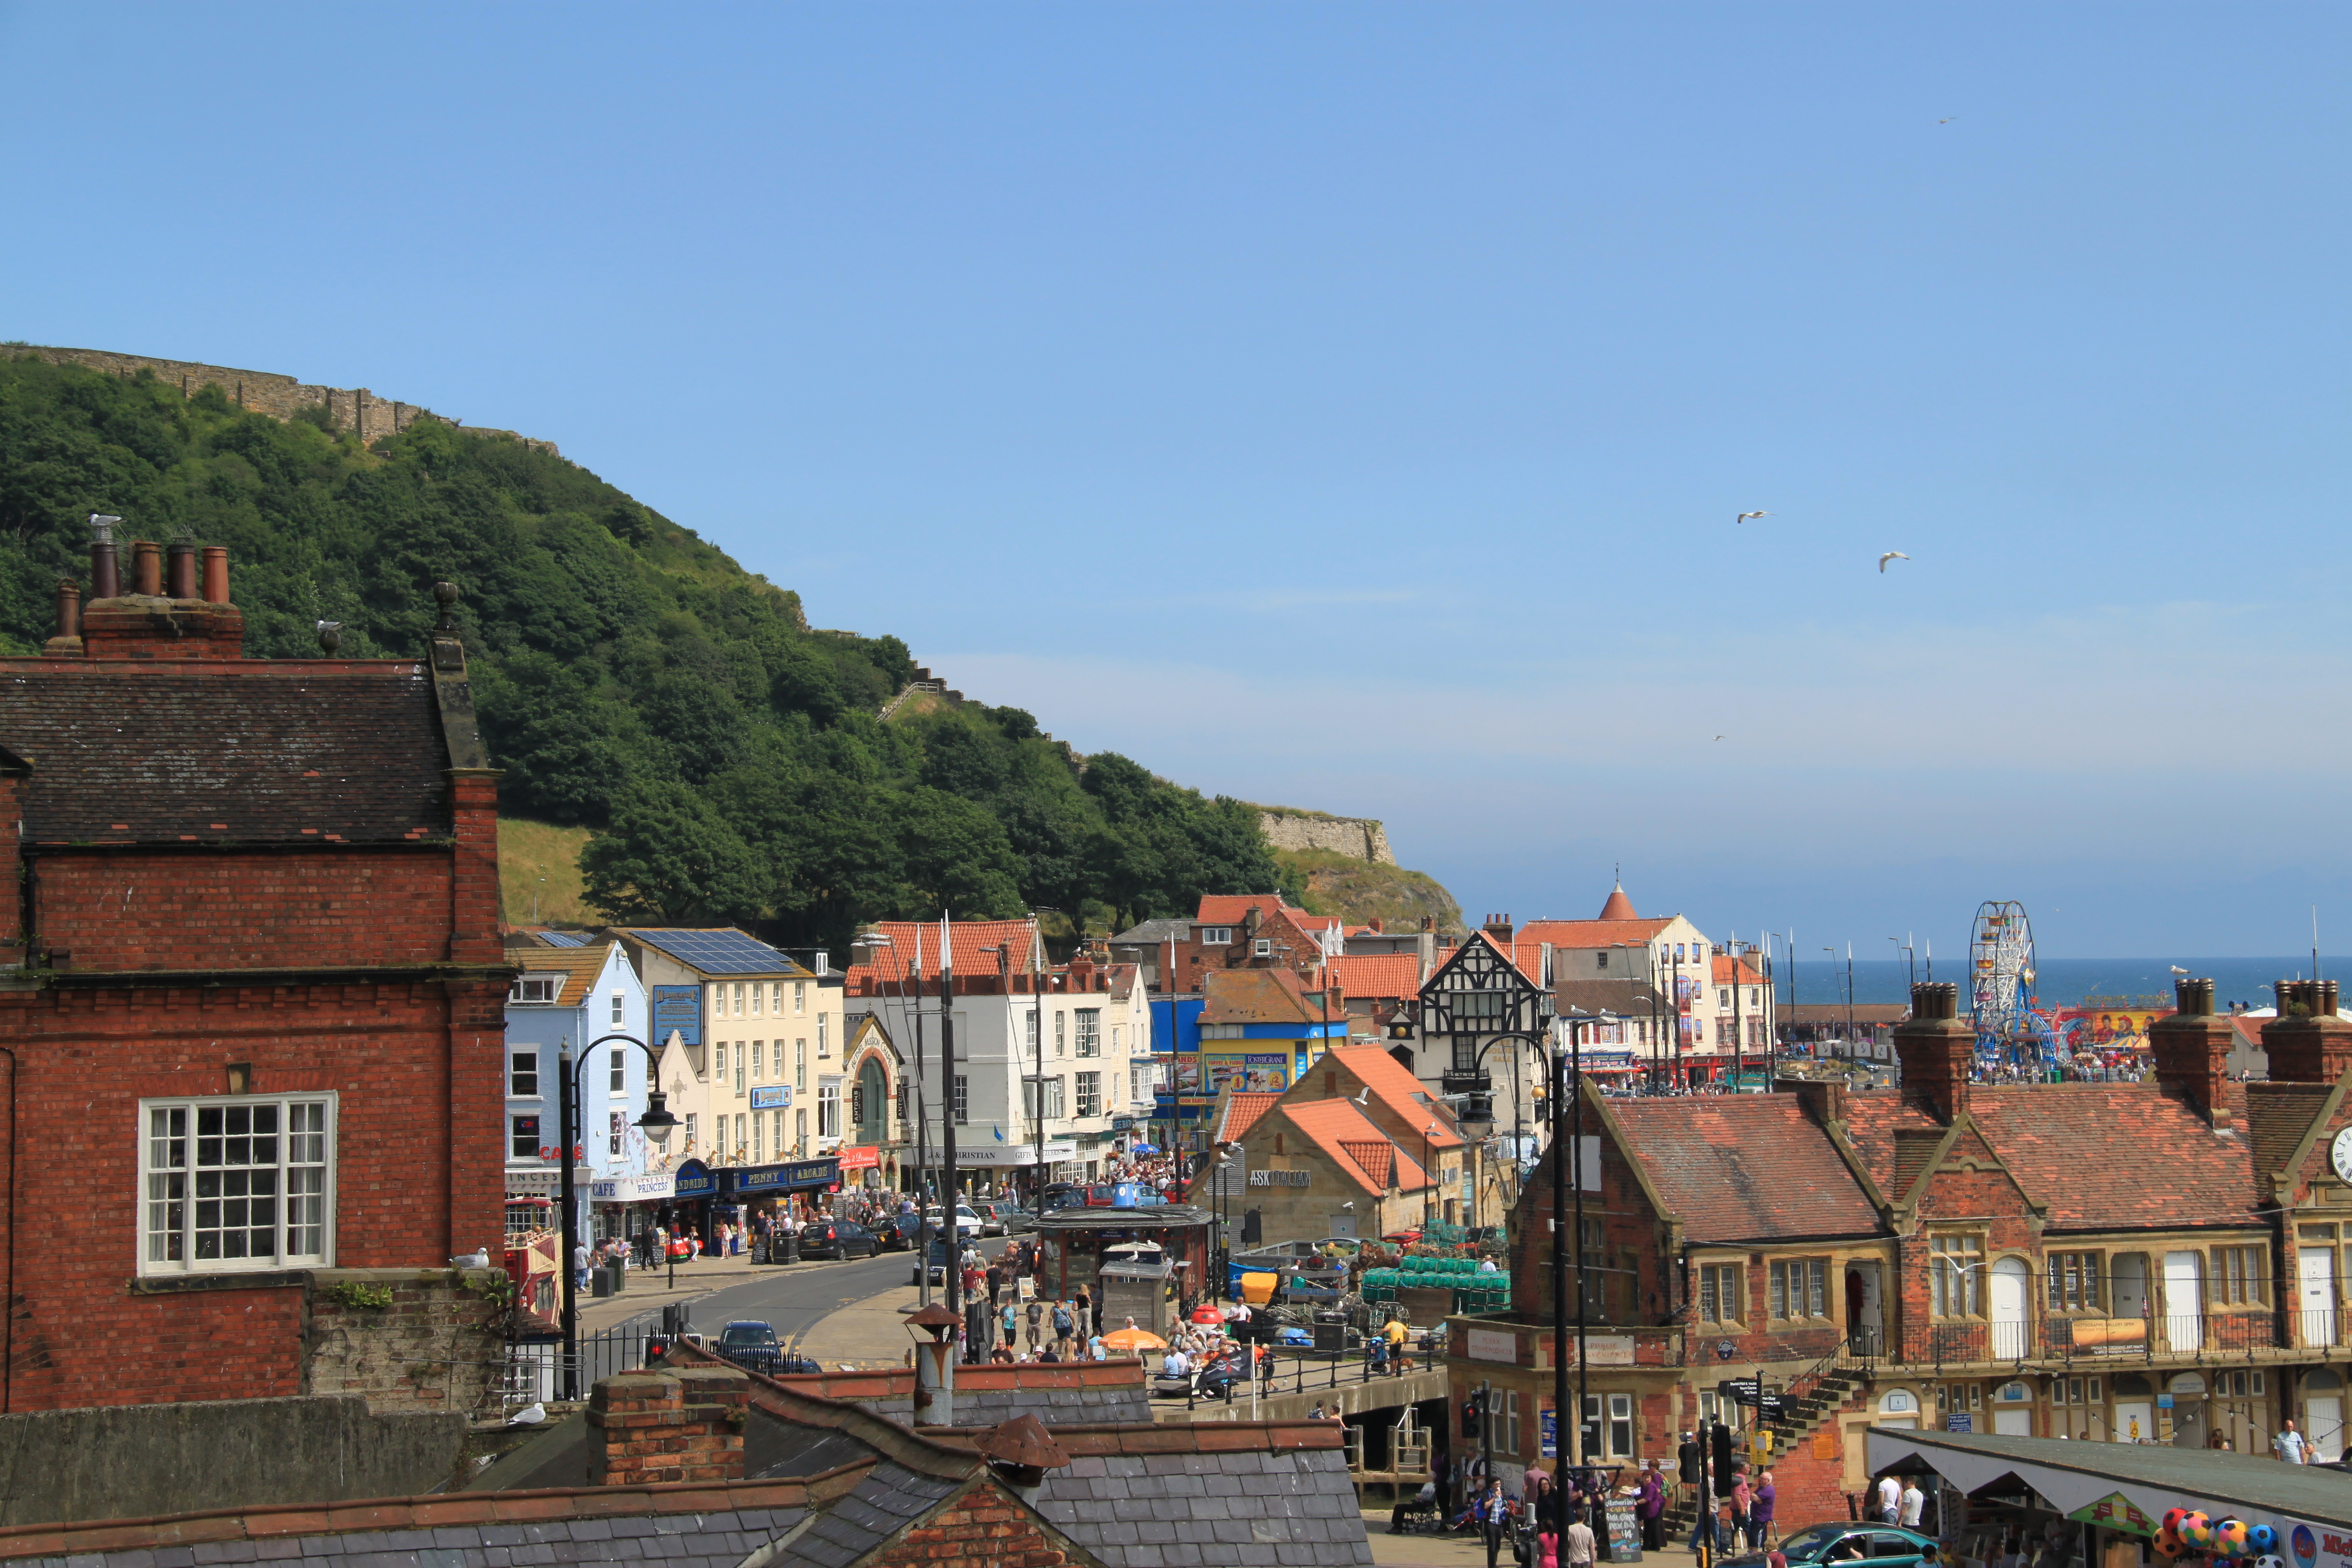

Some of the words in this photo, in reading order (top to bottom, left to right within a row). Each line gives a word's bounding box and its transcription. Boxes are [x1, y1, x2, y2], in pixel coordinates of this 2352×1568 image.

[539, 1143, 583, 1160] CAÉ
[509, 1173, 558, 1182] INCES
[748, 1172, 780, 1185] PENNY
[797, 1166, 828, 1179] ARCADE
[1250, 1170, 1270, 1186] ASK
[1271, 1170, 1310, 1186] ITALIAN
[592, 1183, 615, 1196] CAFE
[637, 1181, 668, 1194] PRINCESS
[675, 1177, 708, 1191] ANDSIDE
[1471, 1345, 1513, 1355] CONVENIENCES
[2112, 1498, 2127, 1508] Roast
[2113, 1514, 2127, 1524] Bake
[2323, 1533, 2352, 1558] Mic
